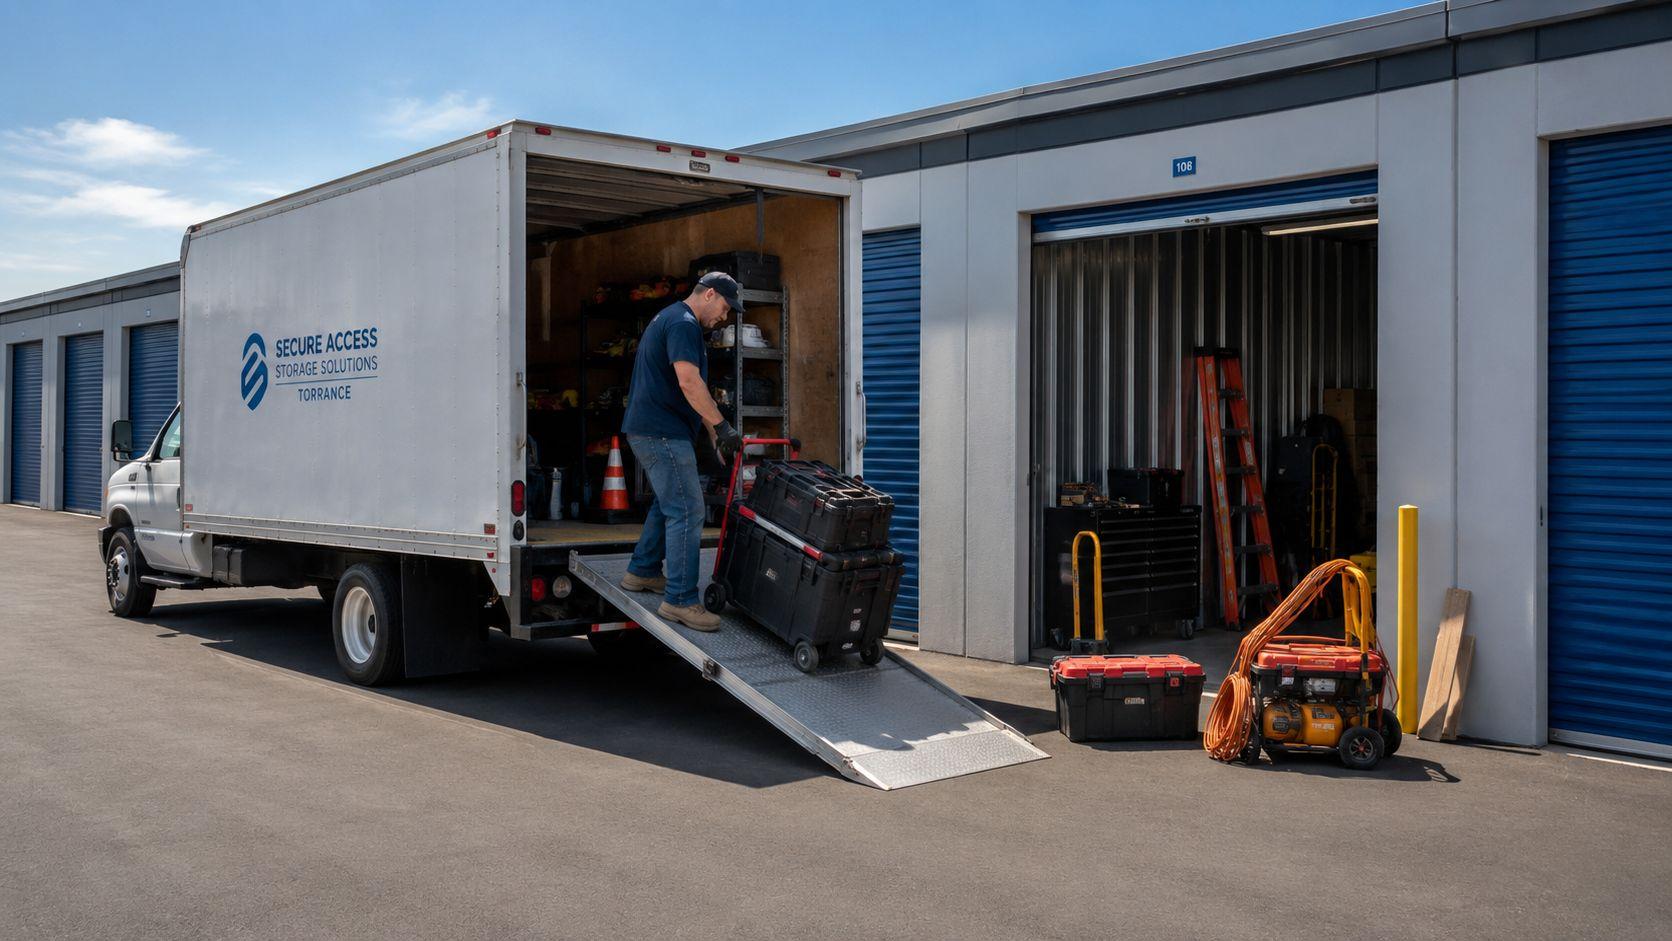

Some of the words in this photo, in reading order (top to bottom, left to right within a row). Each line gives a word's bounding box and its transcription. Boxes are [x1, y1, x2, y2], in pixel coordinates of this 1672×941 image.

[276, 335, 322, 358] SECURE
[326, 327, 377, 353] ACCESS
[275, 361, 318, 379] STORAGE
[321, 355, 378, 375] SOLUTIONS
[298, 385, 351, 402] TORRANCE
